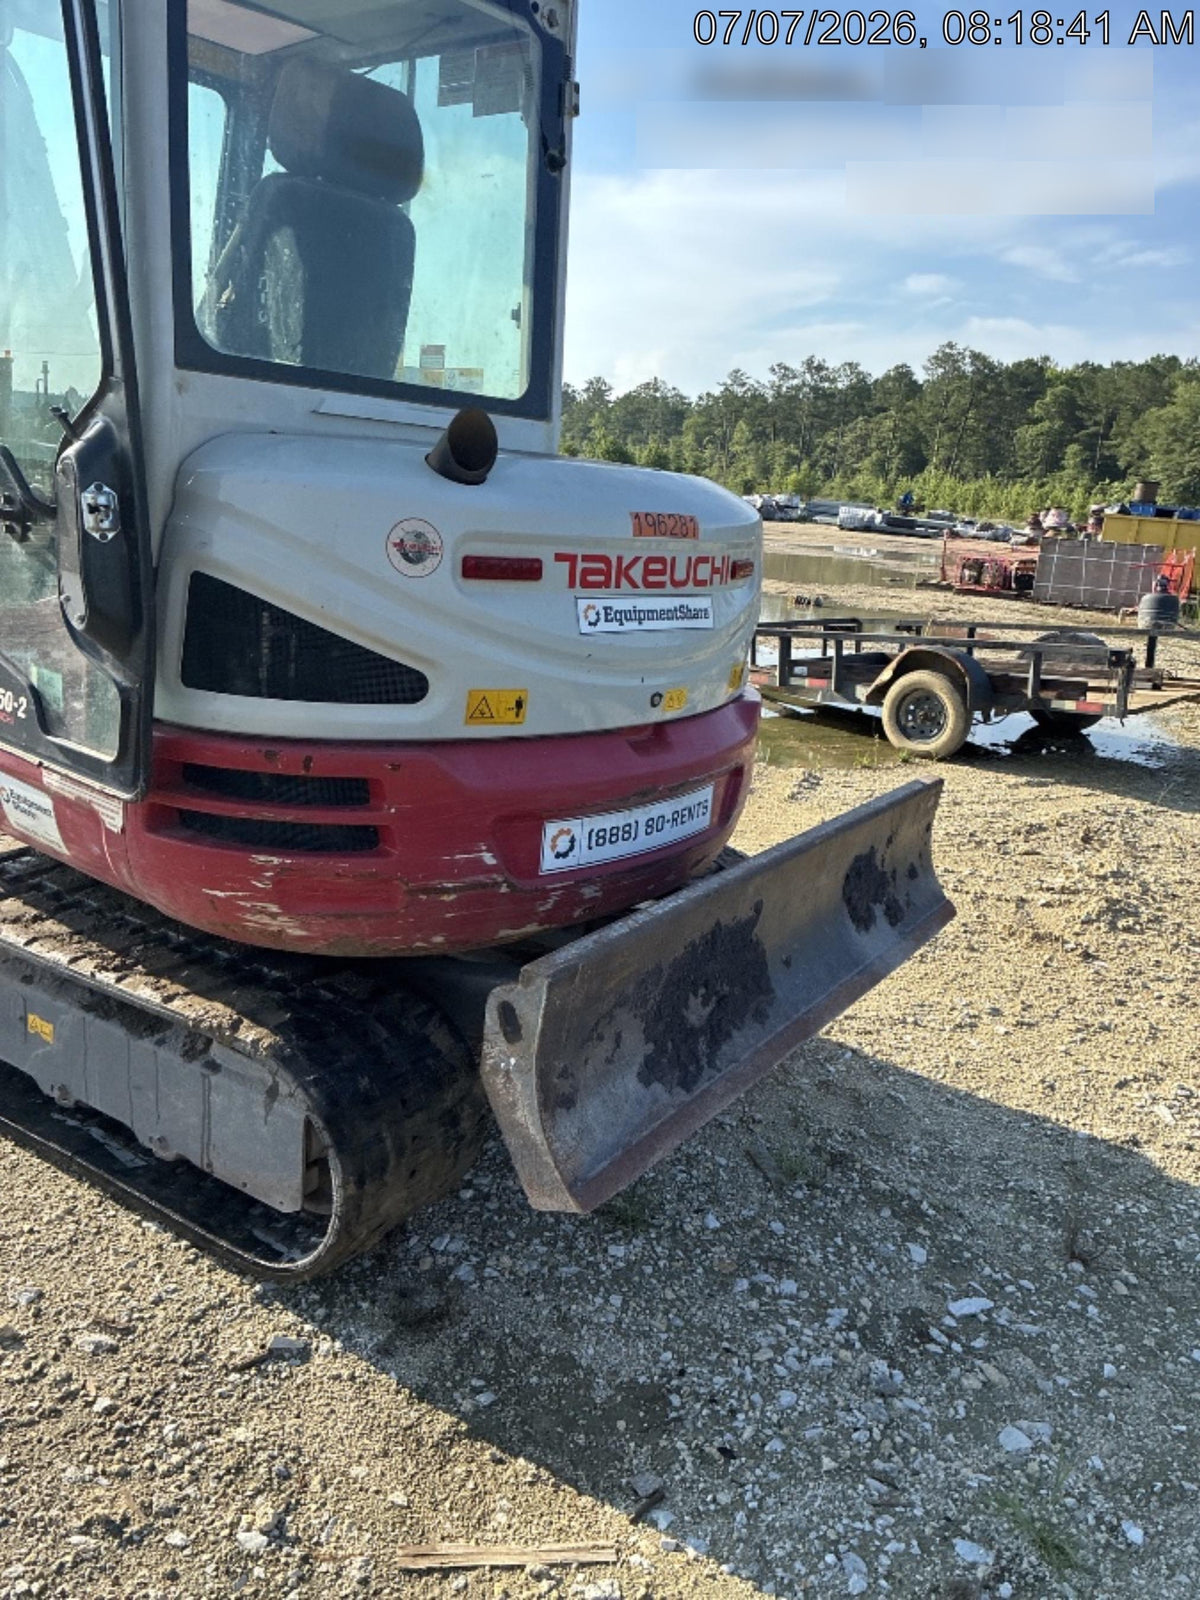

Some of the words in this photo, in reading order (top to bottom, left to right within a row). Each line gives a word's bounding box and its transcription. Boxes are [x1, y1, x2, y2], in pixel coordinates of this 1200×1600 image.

[634, 512, 696, 538] 196281
[603, 604, 710, 625] EquipmentShare
[587, 820, 639, 850] (888)
[644, 798, 709, 836] 80-RENTS
